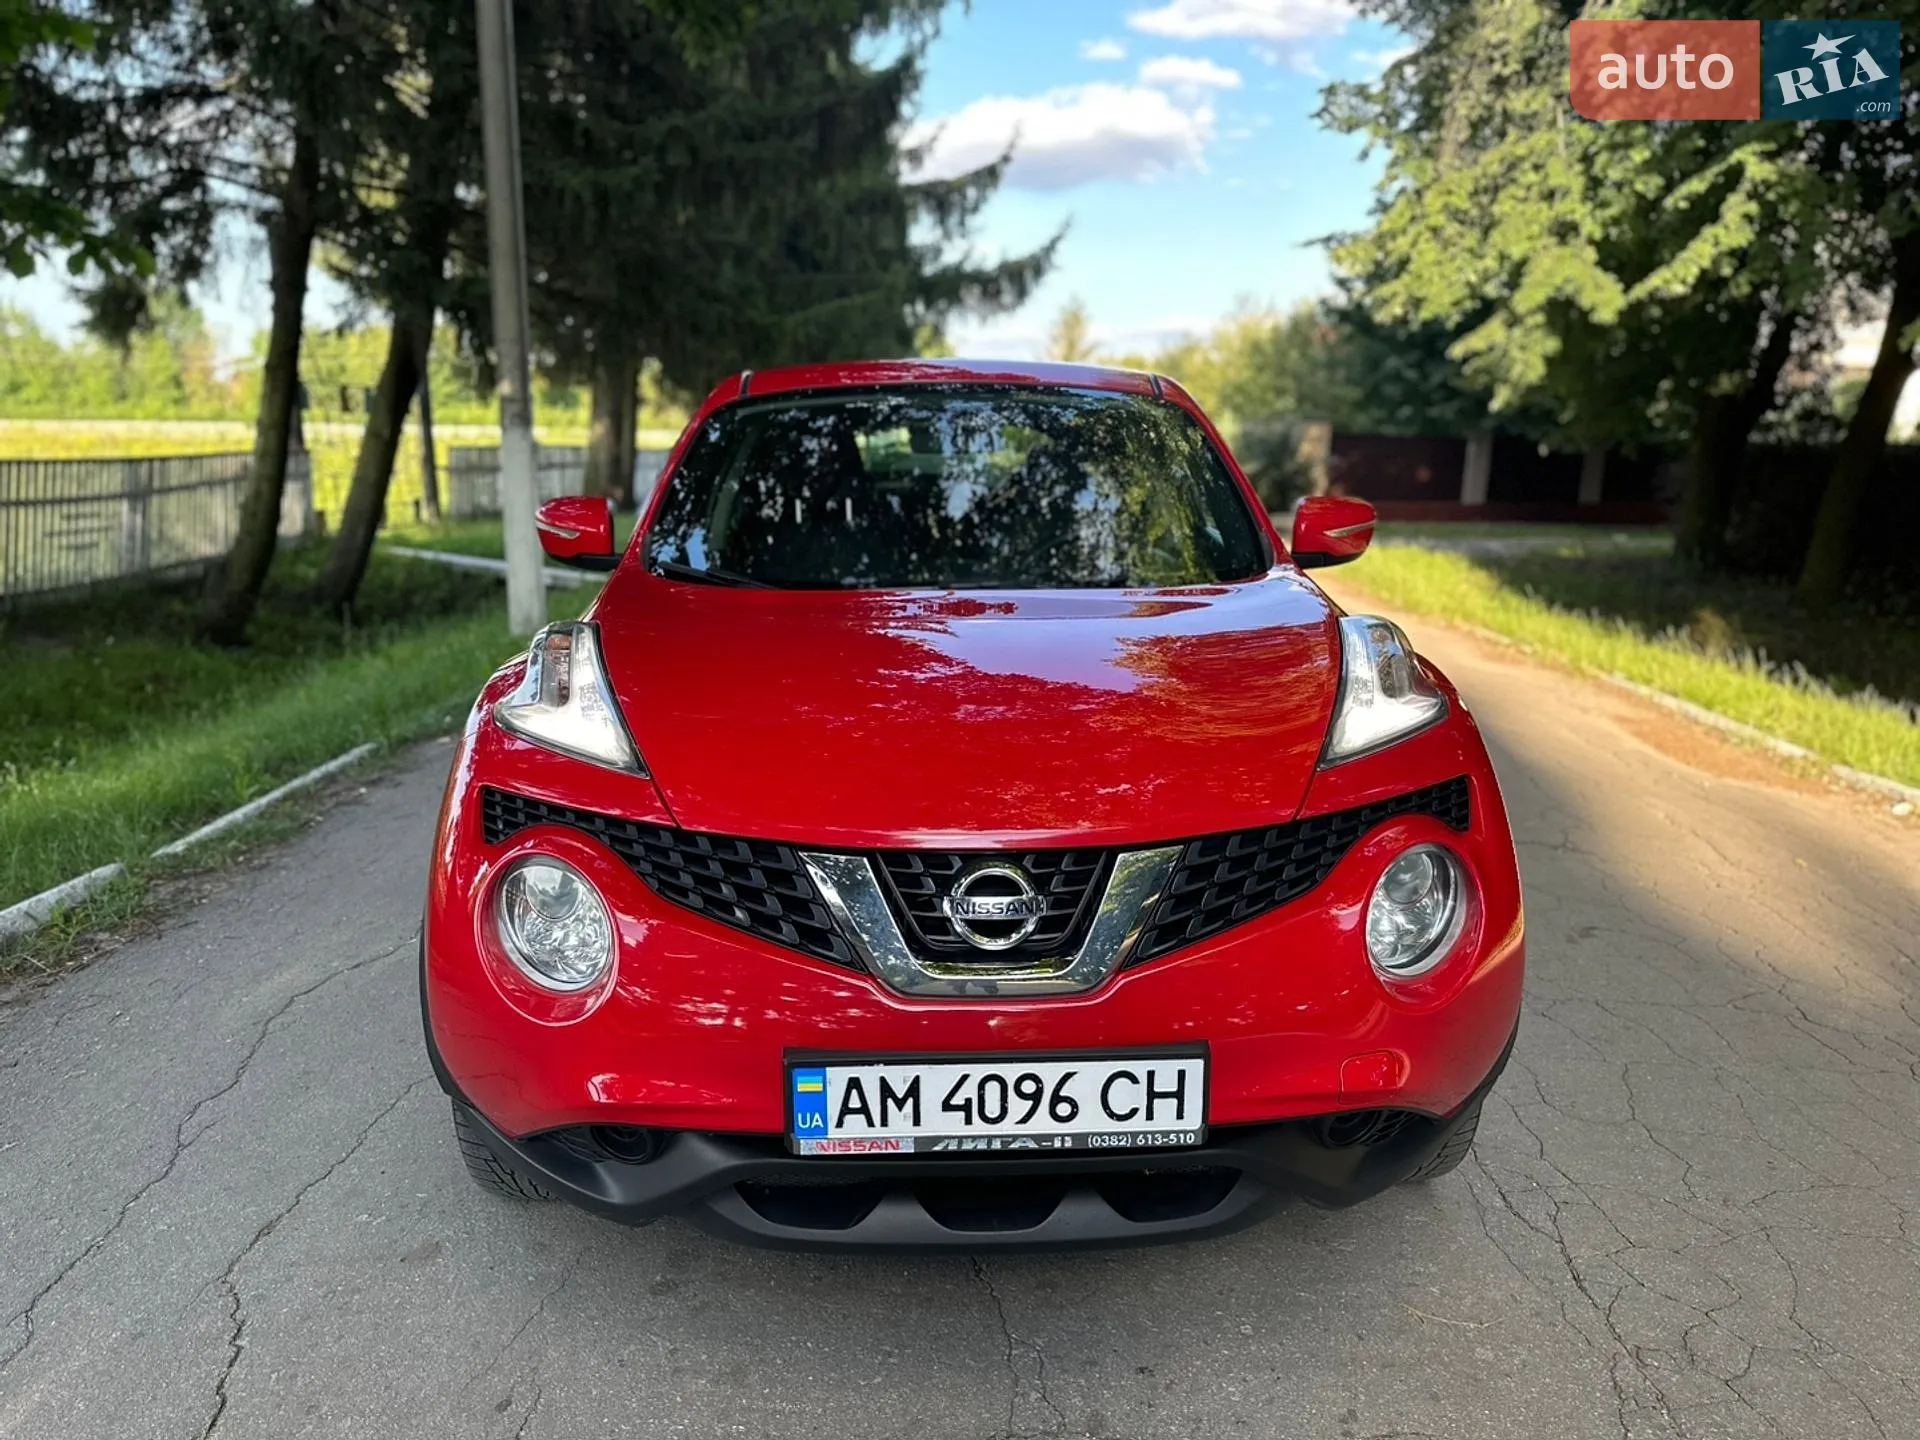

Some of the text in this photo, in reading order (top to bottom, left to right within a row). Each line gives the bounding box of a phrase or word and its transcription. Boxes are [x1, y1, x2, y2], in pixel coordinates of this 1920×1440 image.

[955, 902, 1034, 916] NISSAN
[834, 1068, 1187, 1129] AM 4096 CH
[798, 1112, 824, 1128] UA
[815, 1140, 901, 1153] NISSAN
[1088, 1134, 1132, 1148] (0382)
[1136, 1132, 1195, 1145] 613-510
